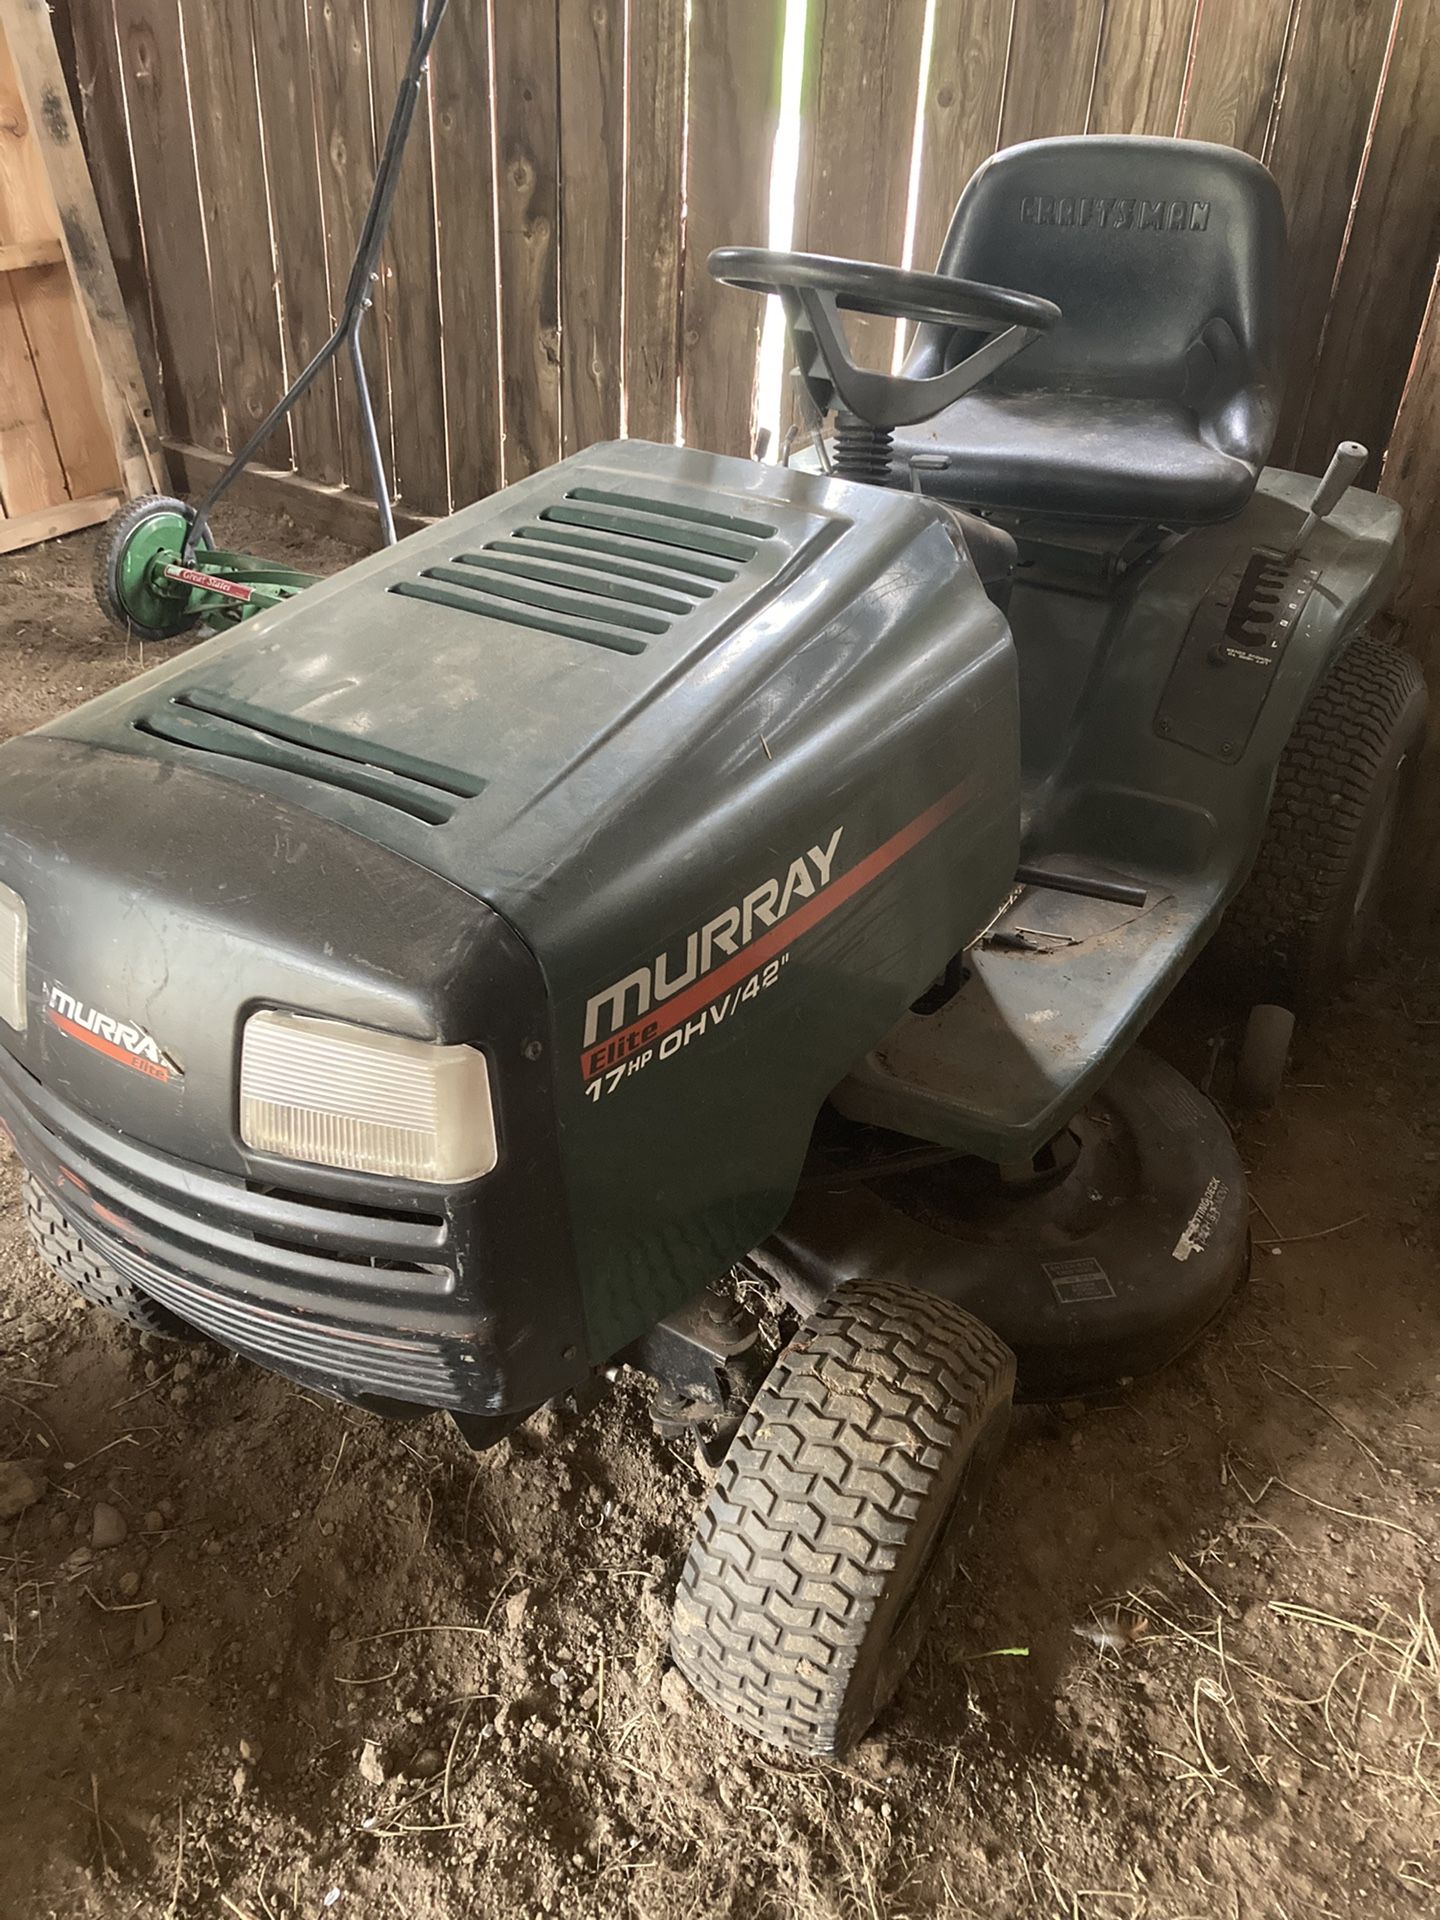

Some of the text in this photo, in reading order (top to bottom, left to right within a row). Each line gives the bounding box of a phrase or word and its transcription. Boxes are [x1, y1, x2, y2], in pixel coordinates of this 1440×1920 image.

[1020, 197, 1210, 231] CRAFTSMAN
[182, 569, 231, 592] Great States
[583, 826, 844, 1049] MURRAY
[589, 1020, 658, 1075] Elite
[131, 1056, 165, 1079] Elite
[1204, 1176, 1220, 1199] DECK
